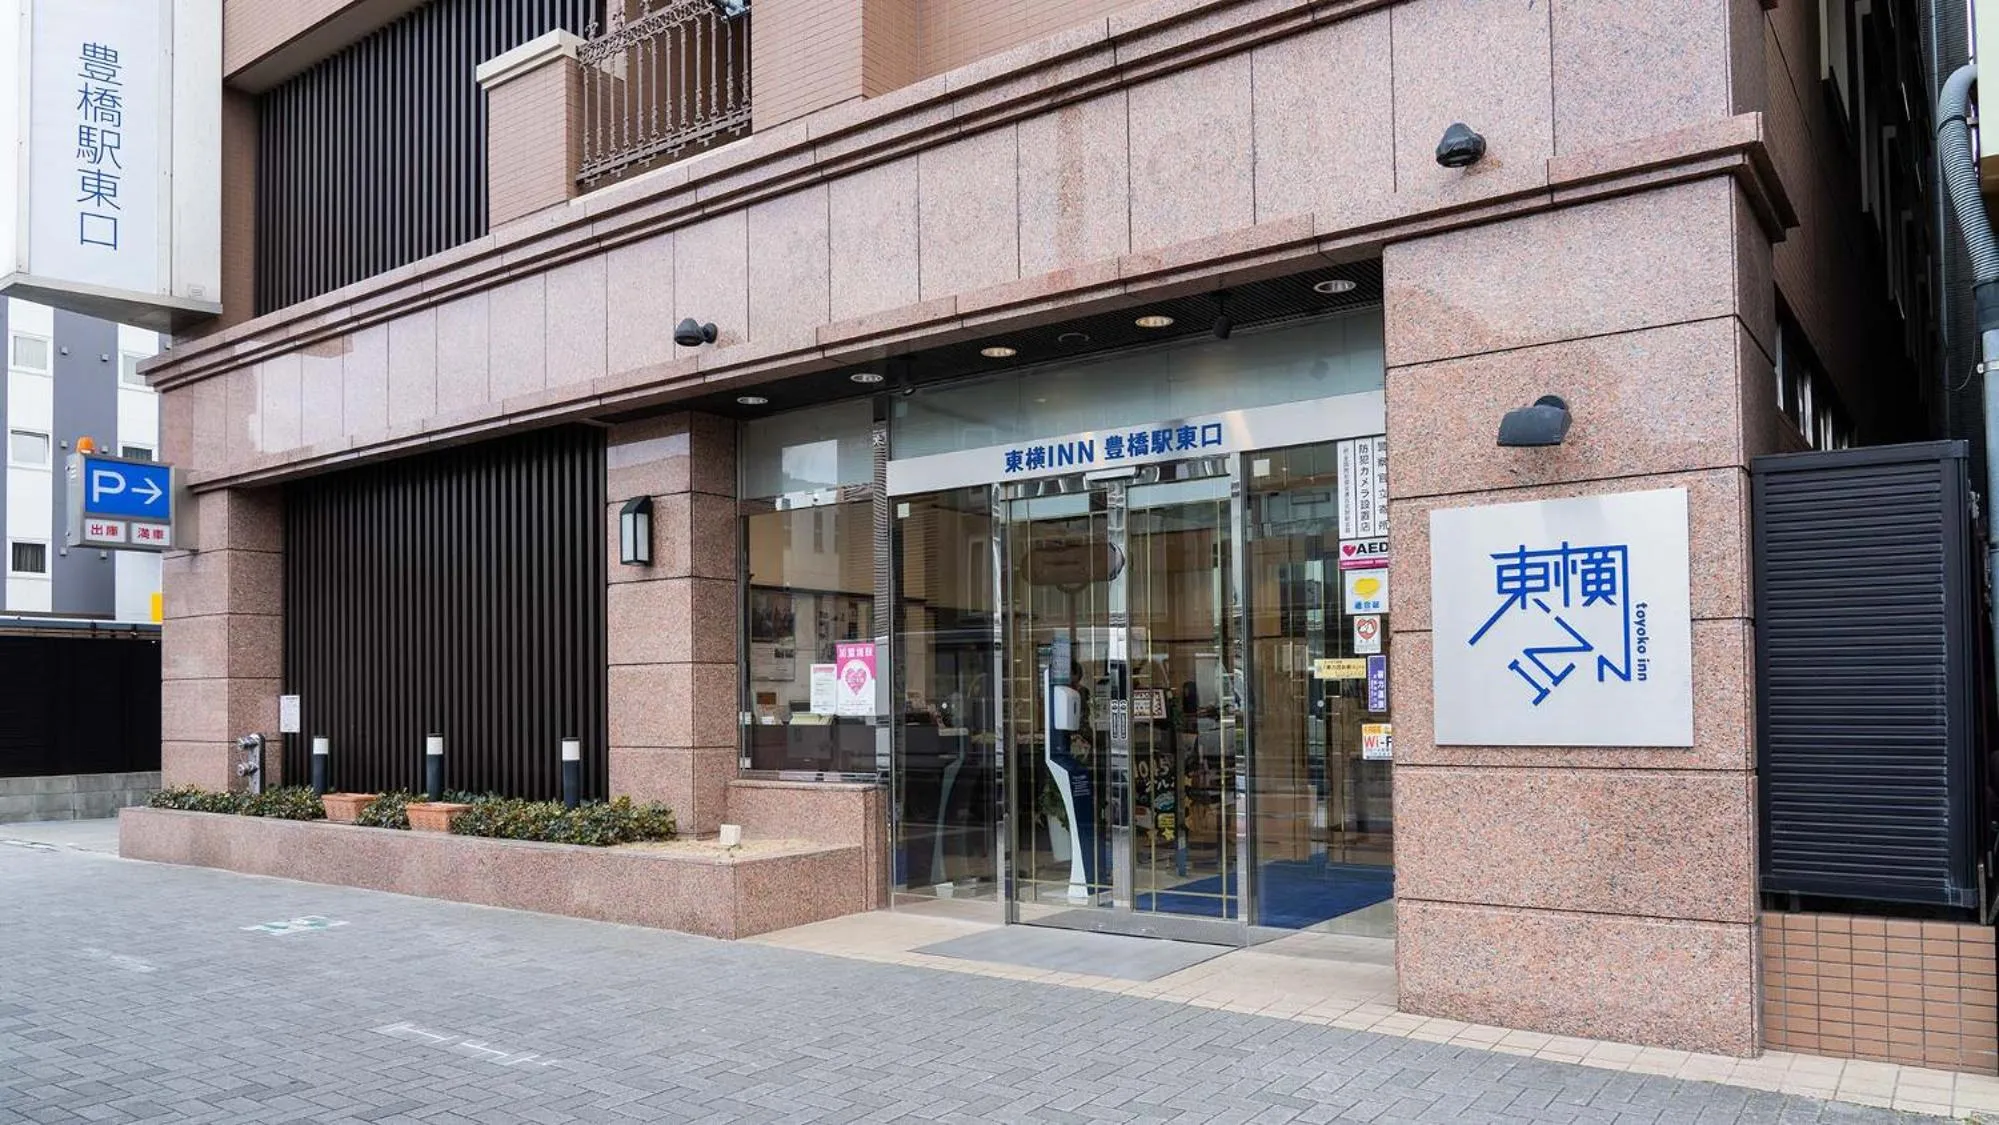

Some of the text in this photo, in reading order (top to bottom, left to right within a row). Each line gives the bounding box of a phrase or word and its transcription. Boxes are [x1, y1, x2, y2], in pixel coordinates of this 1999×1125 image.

[76, 42, 123, 251] 豊橋駅東口
[1004, 422, 1222, 473] 東横INN 豊橋駅東口
[92, 469, 127, 504] P
[1356, 542, 1389, 555] AED
[1635, 602, 1650, 682] toyoko inn
